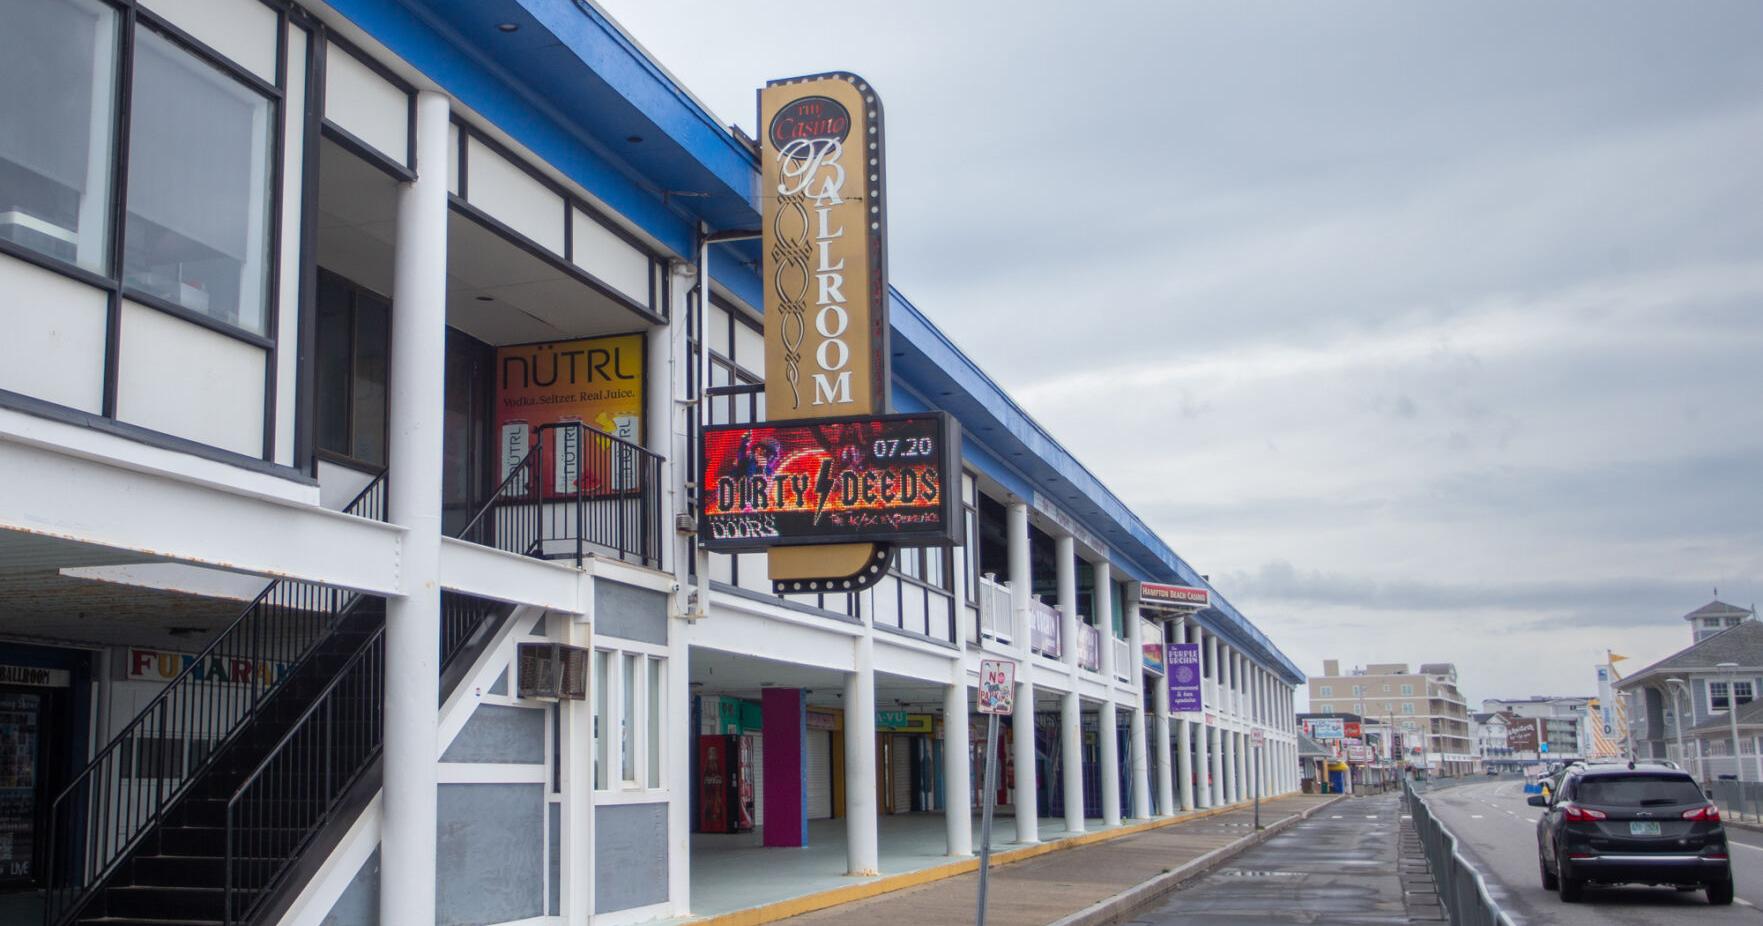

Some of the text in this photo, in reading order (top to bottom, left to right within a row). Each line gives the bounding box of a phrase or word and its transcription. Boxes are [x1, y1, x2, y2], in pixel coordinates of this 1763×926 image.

[775, 117, 847, 140] Casino
[580, 390, 603, 402] Real
[605, 387, 635, 400] Juice.
[873, 437, 932, 457] 07.20
[718, 472, 811, 512] DIRTY
[840, 467, 938, 506] DEEDS
[710, 519, 779, 539] DOORS
[989, 671, 1005, 684] NO
